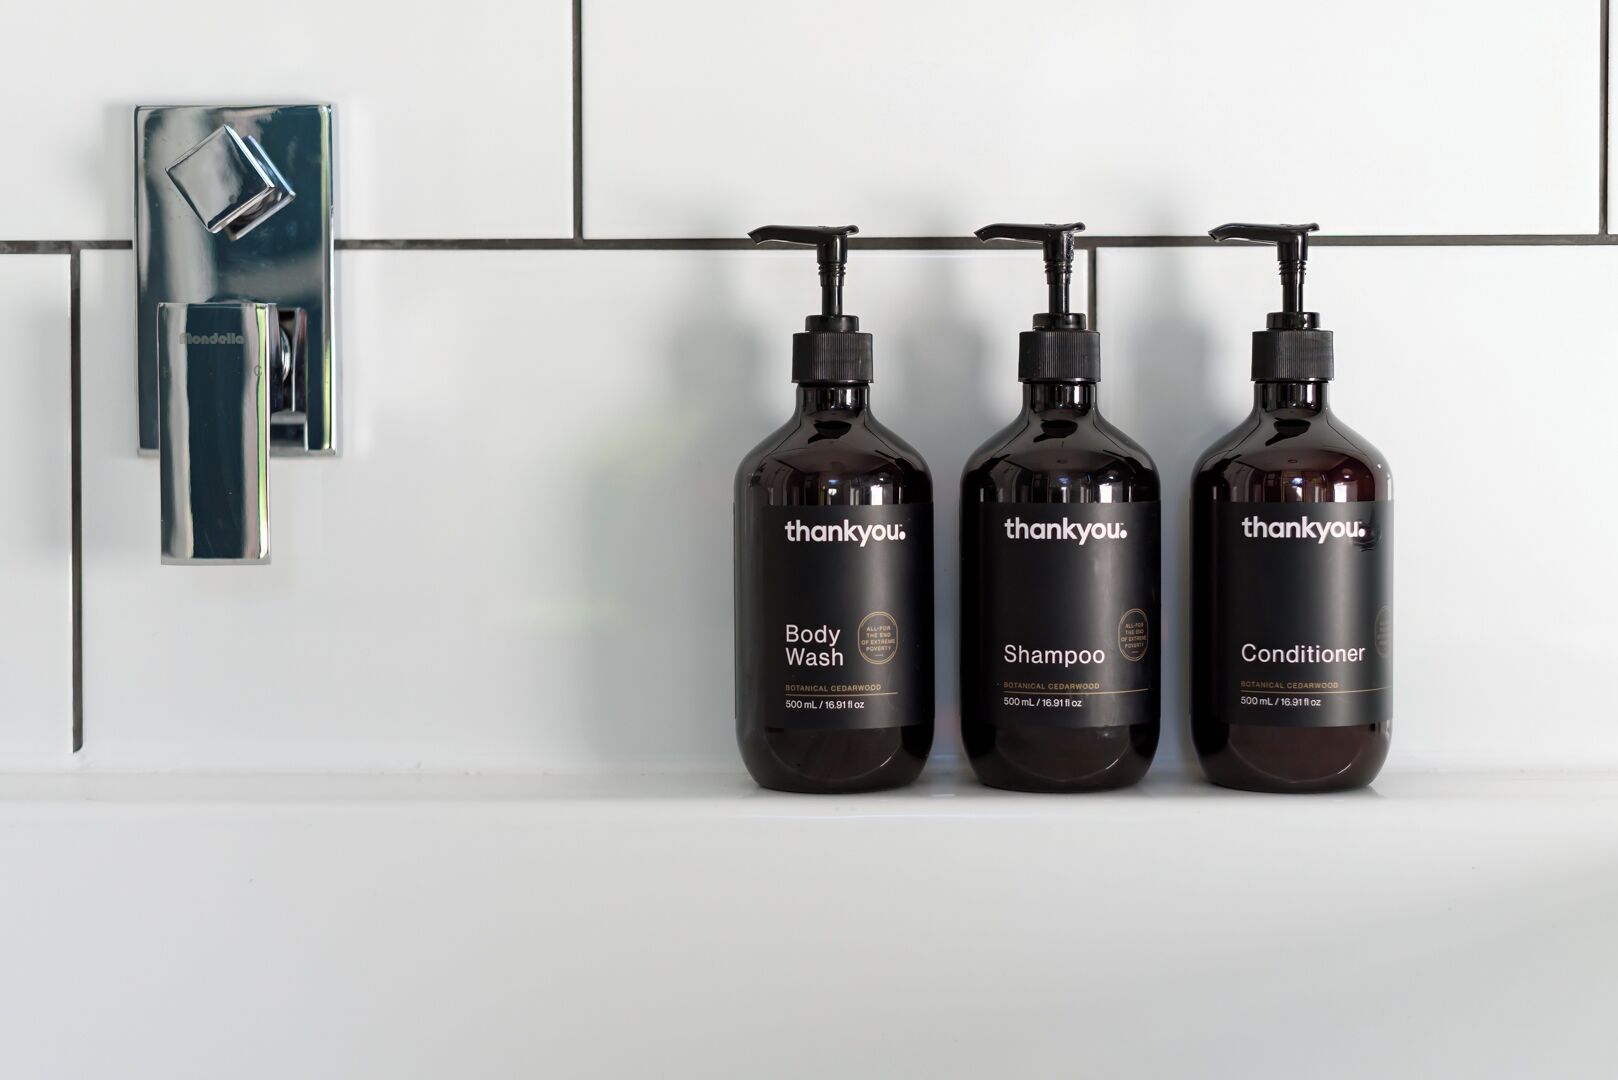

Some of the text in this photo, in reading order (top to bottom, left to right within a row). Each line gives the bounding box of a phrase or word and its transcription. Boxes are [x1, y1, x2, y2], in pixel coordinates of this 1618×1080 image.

[785, 624, 841, 647] Body
[785, 647, 844, 667] Wash
[1003, 644, 1106, 668] Shampoo
[1241, 643, 1366, 663] Conditioner
[785, 684, 882, 692] BOTANICAL CEDARWOOD
[1003, 681, 1100, 690] BOTANICAL CEDARWOOD
[1240, 680, 1339, 689] BOTANICAL CEDARWOOD
[785, 700, 803, 709] 500
[804, 700, 818, 710] mL
[824, 701, 847, 710] 16.91
[854, 701, 865, 709] oz
[1003, 697, 1021, 706] 500
[1021, 698, 1035, 707] mL
[1042, 698, 1064, 708] 16.91
[1071, 699, 1083, 707] oz
[1240, 696, 1258, 705] 500
[1259, 697, 1273, 706] mL
[1280, 697, 1303, 707] 16.91
[1310, 698, 1321, 706] oz
